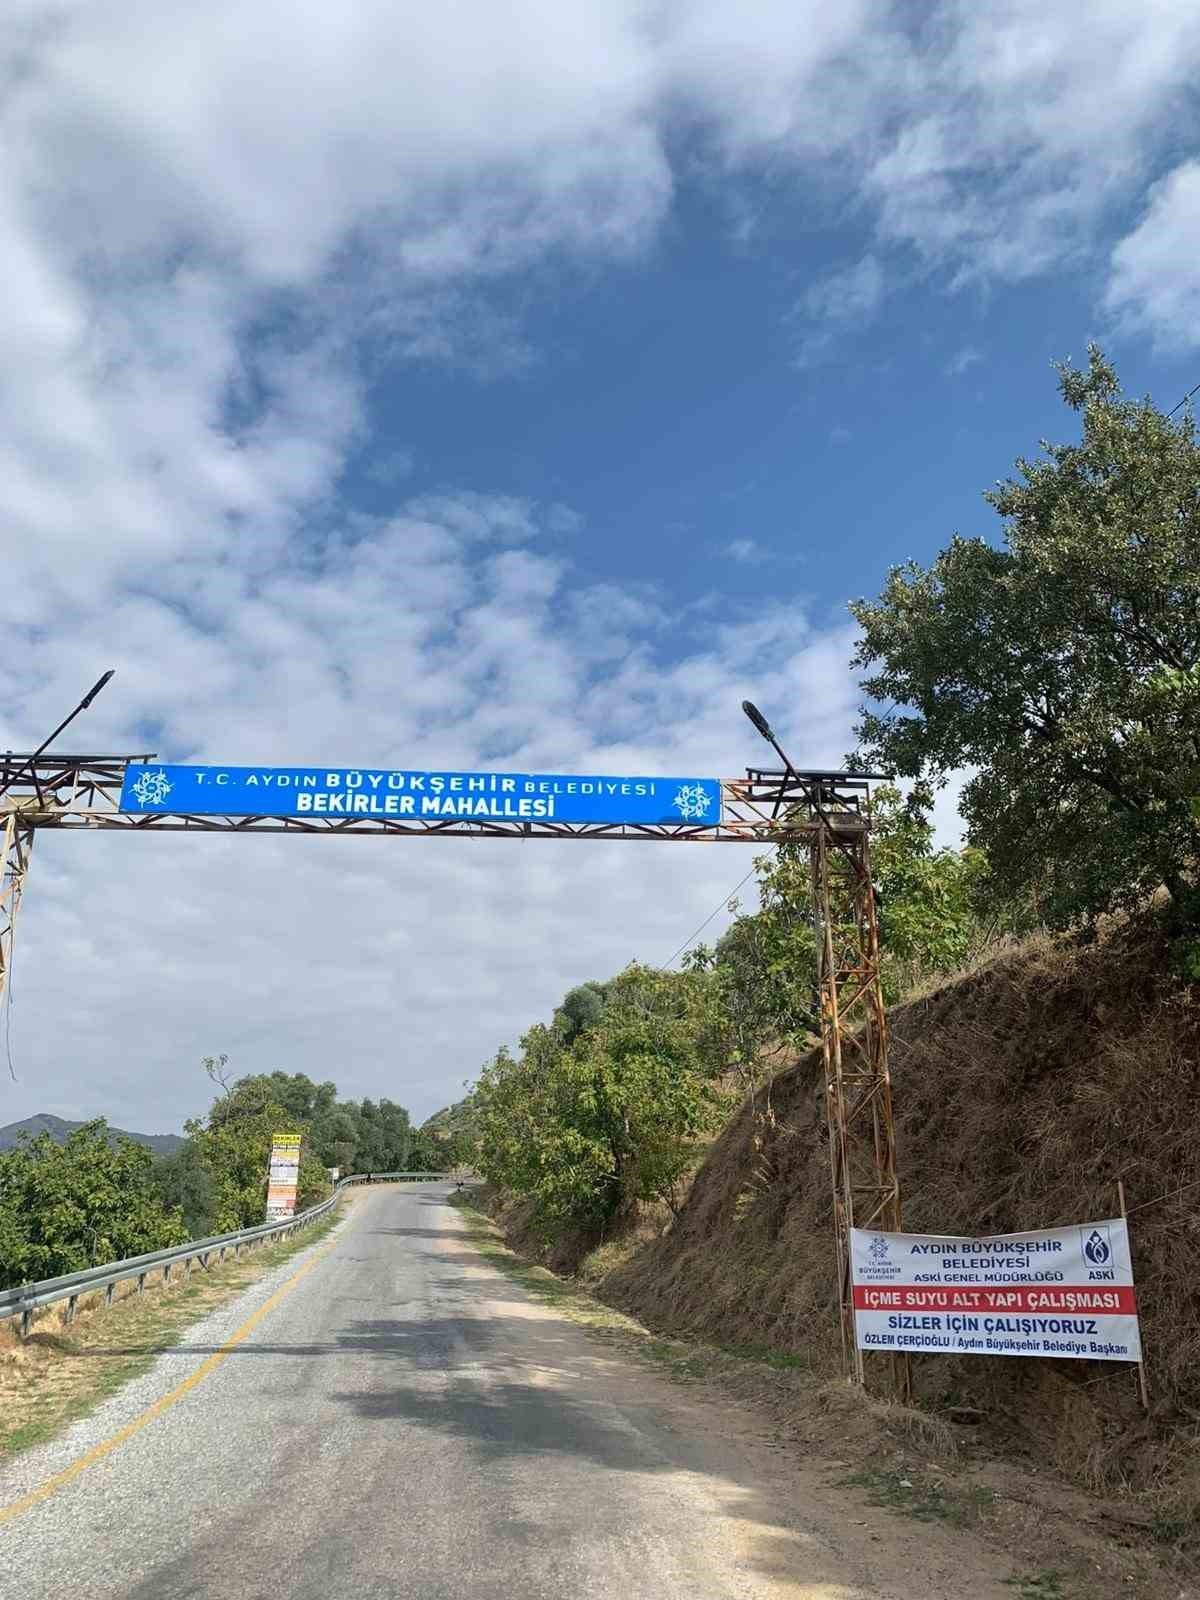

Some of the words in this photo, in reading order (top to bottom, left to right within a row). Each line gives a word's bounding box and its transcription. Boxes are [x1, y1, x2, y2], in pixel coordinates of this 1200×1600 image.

[246, 775, 317, 788] AYDIN
[326, 770, 516, 794] BÜYÜKŞEHİR
[525, 781, 656, 796] BELEDİYESİ
[297, 789, 415, 814] BEKİRLER
[422, 795, 555, 817] MAHALLESİ
[911, 1244, 957, 1255] AYDIN
[961, 1240, 1063, 1256] BÜYÜKŞEHİR
[943, 1256, 1030, 1269] BELEDİYESİ
[914, 1272, 941, 1282] ASKİ
[944, 1274, 981, 1282] GENEL
[984, 1271, 1064, 1282] MÜDÜRLÜĞÜ
[1088, 1269, 1115, 1280] ASKİ
[864, 1289, 902, 1308] İÇME
[906, 1293, 947, 1306] SUYU
[952, 1293, 981, 1306] ALT
[985, 1293, 1022, 1307] YAPI
[1027, 1293, 1120, 1311] ÇALIŞMASI
[888, 1313, 942, 1330] SİZLER
[946, 1314, 979, 1333] İÇİN
[984, 1317, 1098, 1336] ÇALIŞIYORUZ
[864, 1332, 895, 1345] ÖZLEM
[897, 1332, 950, 1348] ÇERÇİOĞLU
[957, 1337, 984, 1350] Aydın
[986, 1338, 1040, 1351] Büyükşehir
[1043, 1340, 1087, 1354] Belediye
[1090, 1342, 1128, 1356] Başkanı
